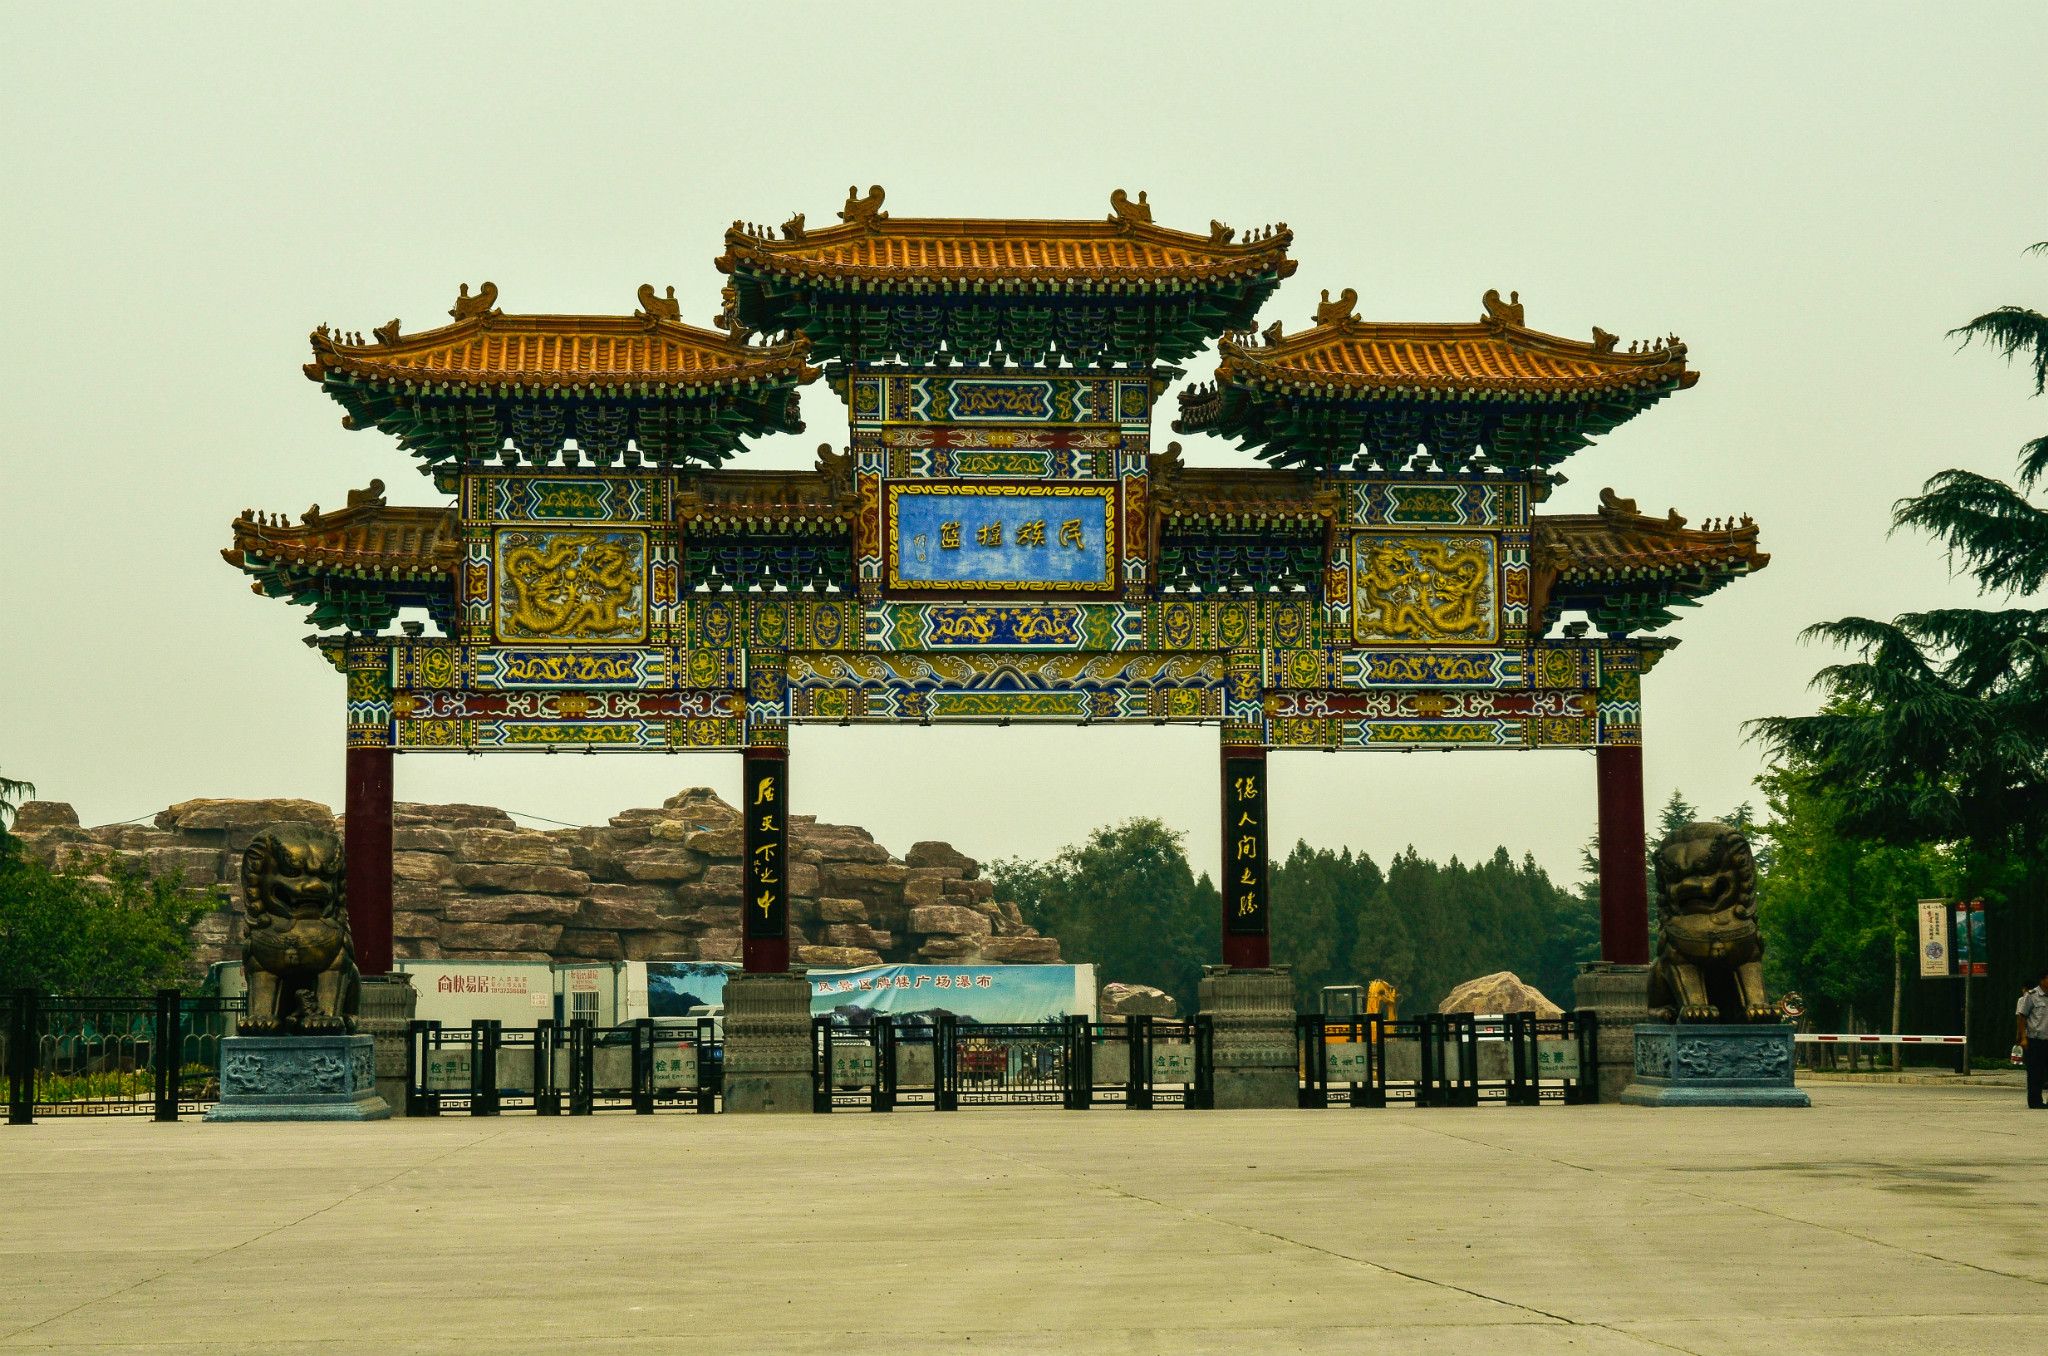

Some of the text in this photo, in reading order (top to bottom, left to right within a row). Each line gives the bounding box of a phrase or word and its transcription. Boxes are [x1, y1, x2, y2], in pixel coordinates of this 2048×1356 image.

[818, 974, 993, 993] 风景区牌楼广场瀑布
